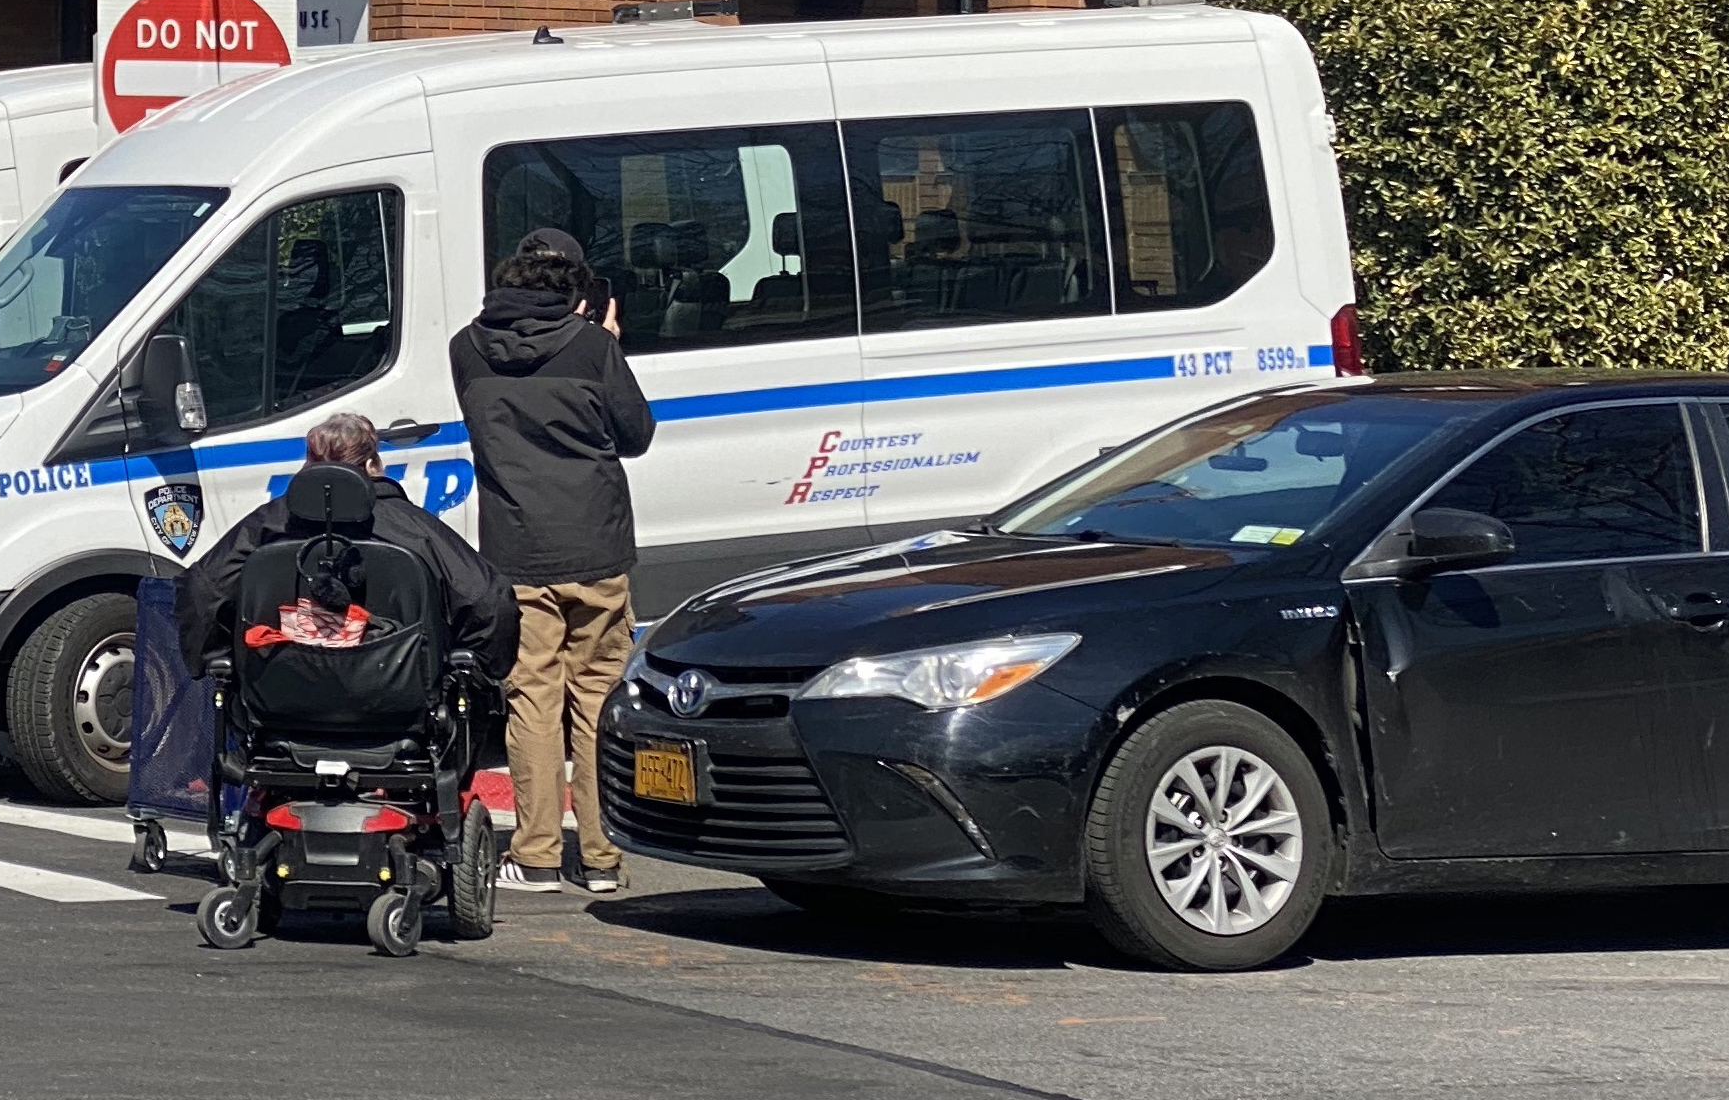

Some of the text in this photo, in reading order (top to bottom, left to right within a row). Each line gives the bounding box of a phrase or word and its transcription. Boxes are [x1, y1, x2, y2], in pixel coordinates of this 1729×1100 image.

[136, 18, 259, 50] DO NOT
[1178, 353, 1197, 377] 43
[1203, 351, 1232, 375] PCT
